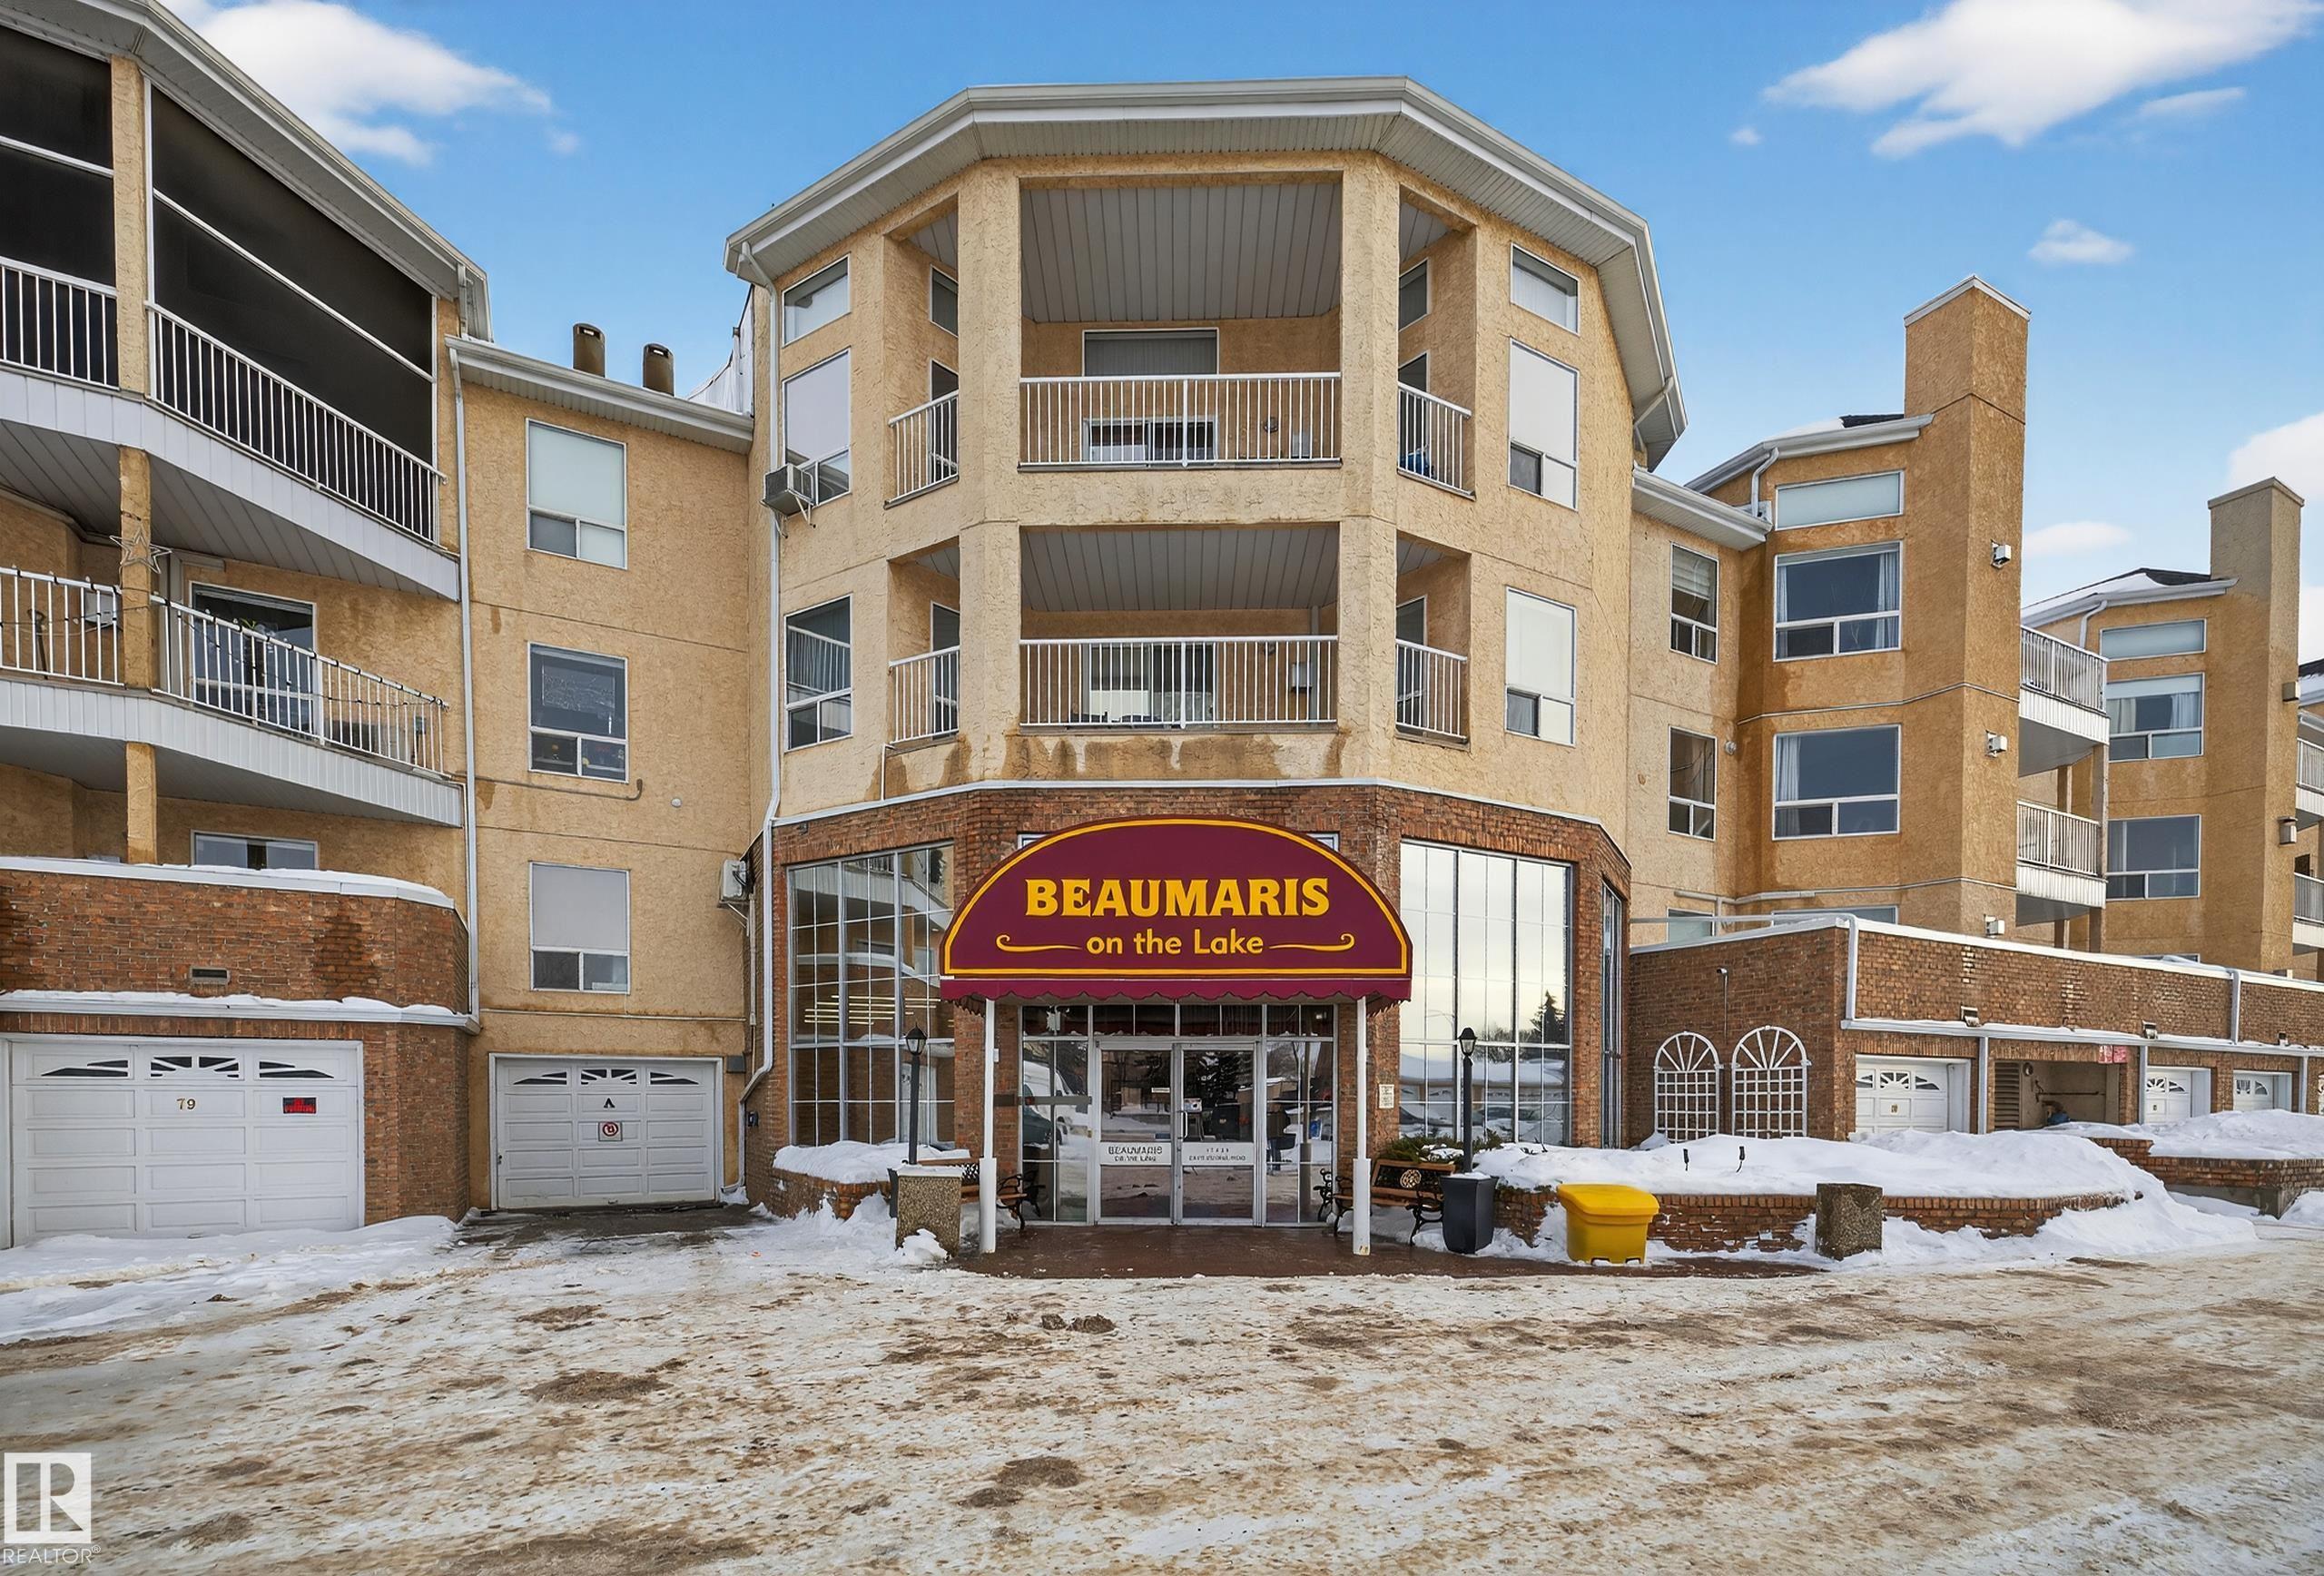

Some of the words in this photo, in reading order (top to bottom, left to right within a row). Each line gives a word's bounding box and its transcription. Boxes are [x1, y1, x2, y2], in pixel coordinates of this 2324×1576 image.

[1025, 877, 1329, 917] BEAUMARIS
[1087, 933, 1123, 954] on
[1134, 929, 1181, 954] the
[1194, 929, 1264, 954] Lake
[176, 1098, 196, 1110] 79
